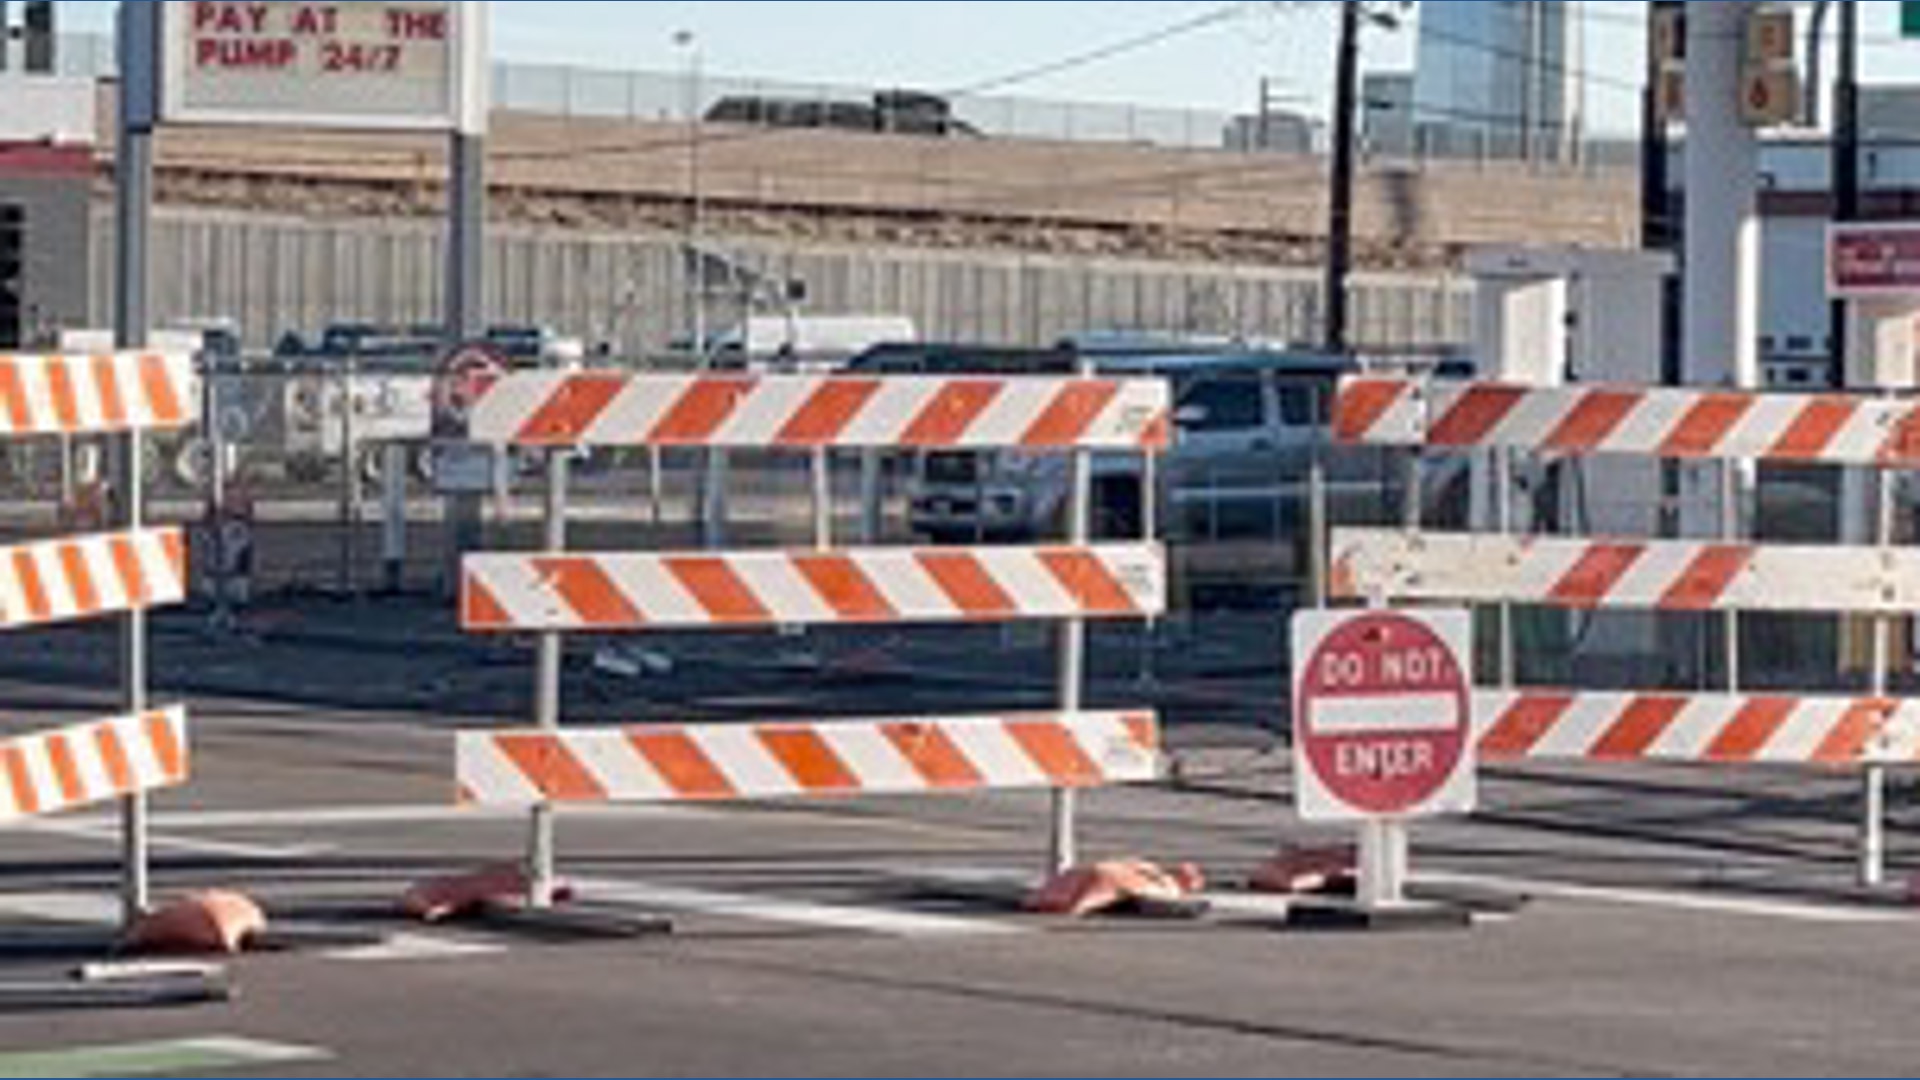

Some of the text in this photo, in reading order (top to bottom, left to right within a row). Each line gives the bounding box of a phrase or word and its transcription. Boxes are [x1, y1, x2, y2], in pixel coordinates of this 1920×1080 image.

[194, 3, 446, 38] PAY AT THE
[195, 38, 402, 71] PUMP 24/7
[1321, 648, 1445, 686] DO NOT
[1335, 742, 1433, 775] ENTER
